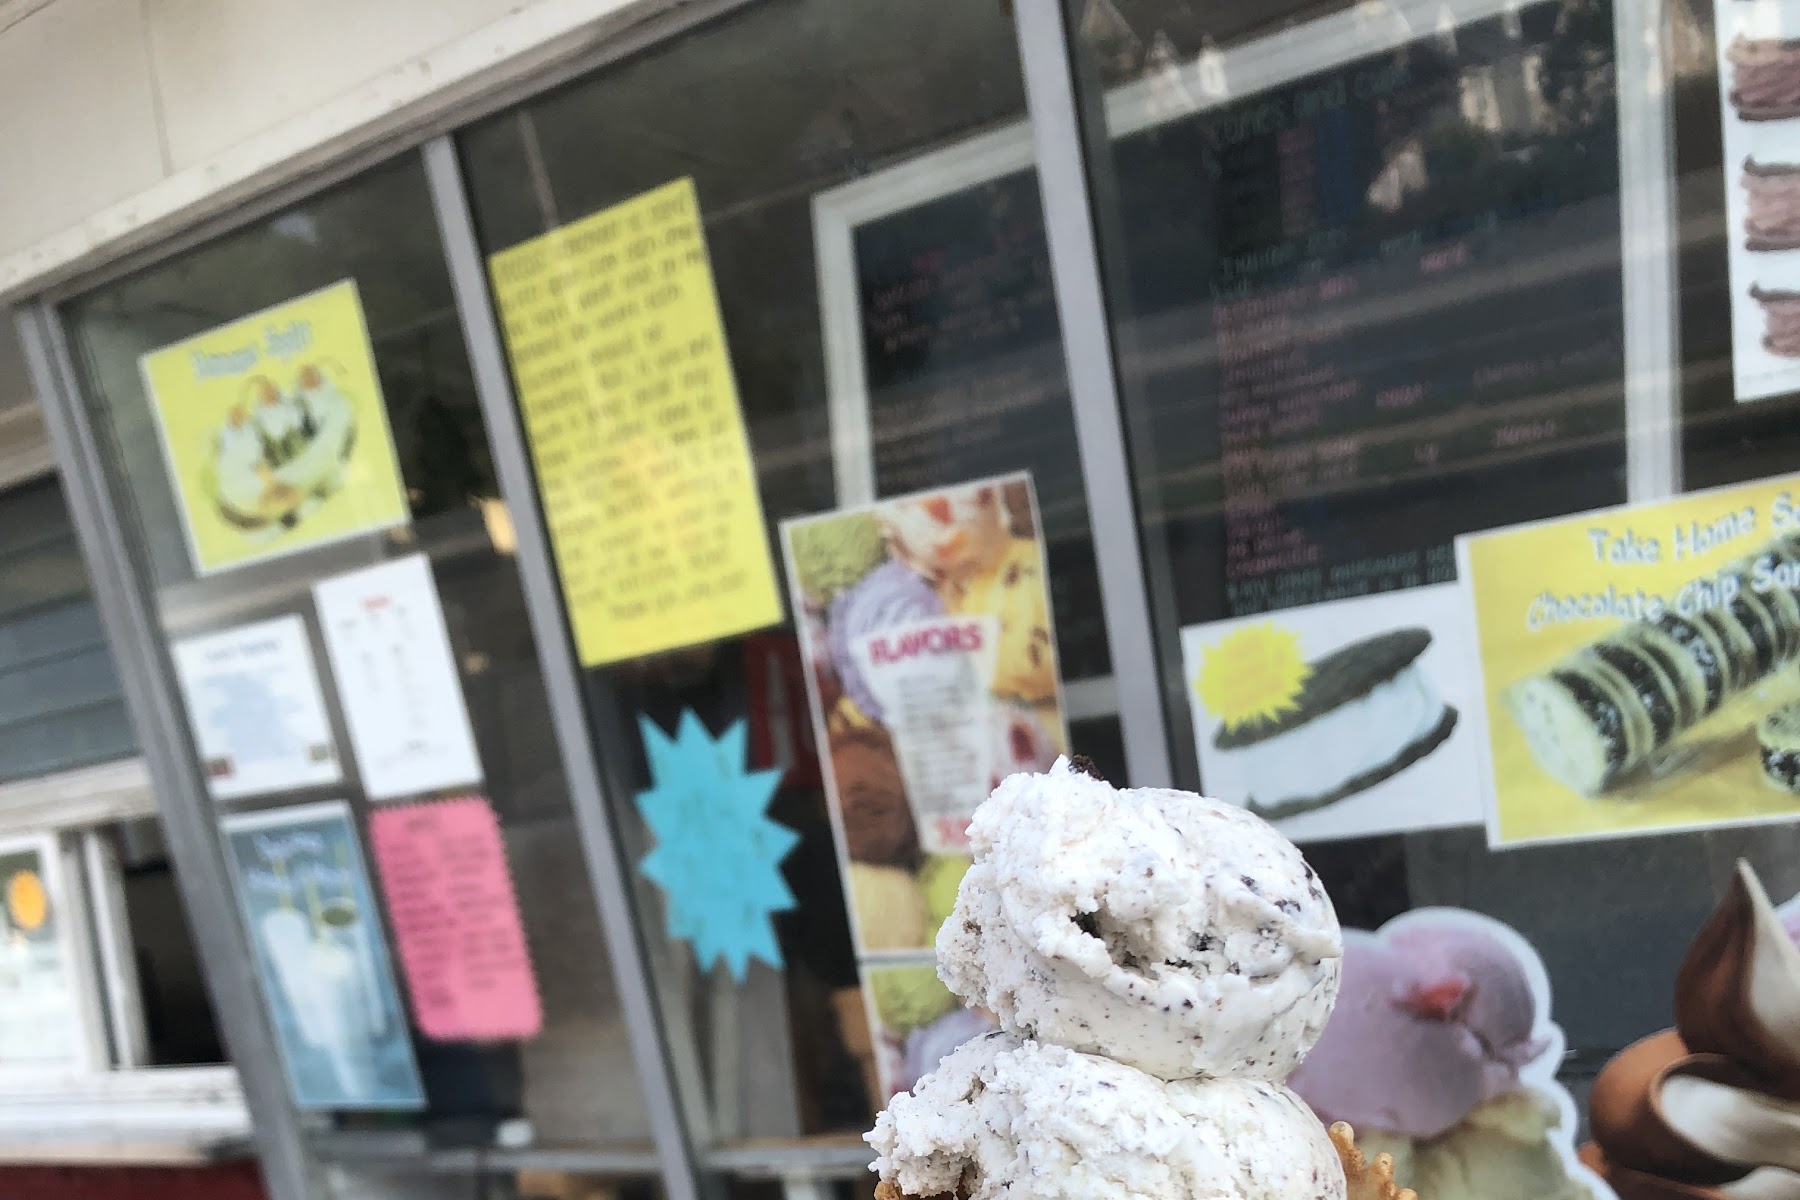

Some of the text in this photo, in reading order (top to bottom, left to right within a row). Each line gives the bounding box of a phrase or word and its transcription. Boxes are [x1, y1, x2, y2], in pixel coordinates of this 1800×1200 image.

[1589, 527, 1661, 566] Take
[1674, 505, 1755, 561] Home
[1527, 584, 1667, 634] Chocolate
[1676, 571, 1740, 620] Chip
[868, 622, 982, 667] FLAVORS
